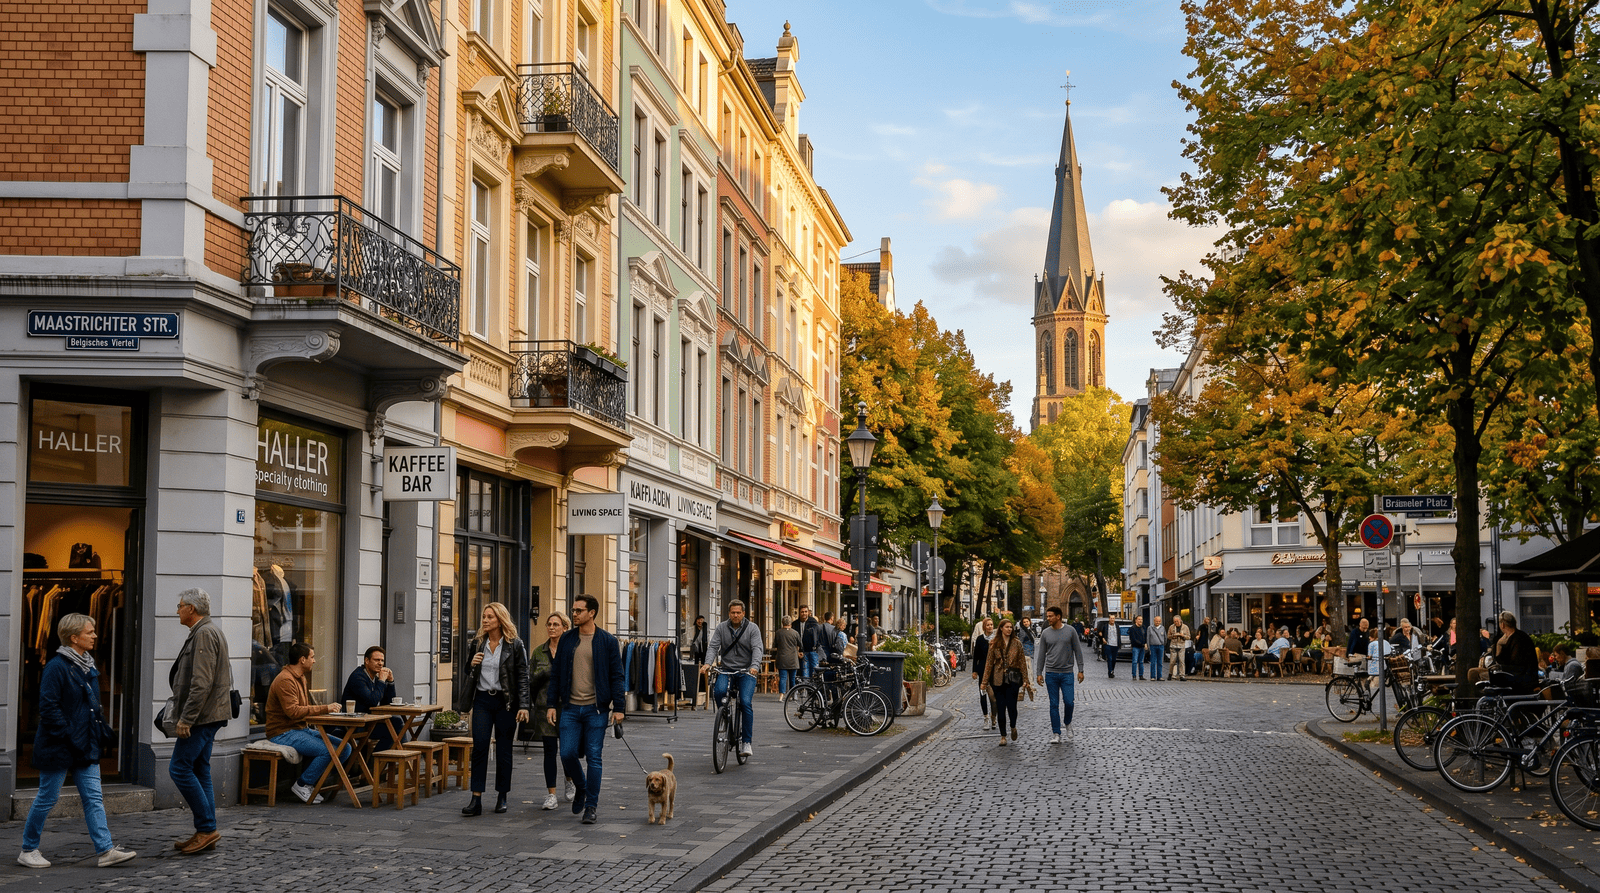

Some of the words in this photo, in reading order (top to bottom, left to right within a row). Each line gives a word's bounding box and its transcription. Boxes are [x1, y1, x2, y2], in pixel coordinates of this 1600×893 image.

[34, 315, 137, 332] MAASTRICHTER
[143, 317, 172, 333] STR.
[70, 337, 109, 348] Belgisches
[111, 338, 135, 347] Viertel
[38, 430, 122, 454] HALLER
[256, 427, 328, 476] HALLER
[389, 455, 446, 473] KAFFEE
[402, 475, 432, 492] BAR
[1426, 497, 1448, 507] Platz
[571, 508, 597, 517] LIVING
[598, 508, 623, 517] SPACE
[696, 502, 712, 521] SPACE
